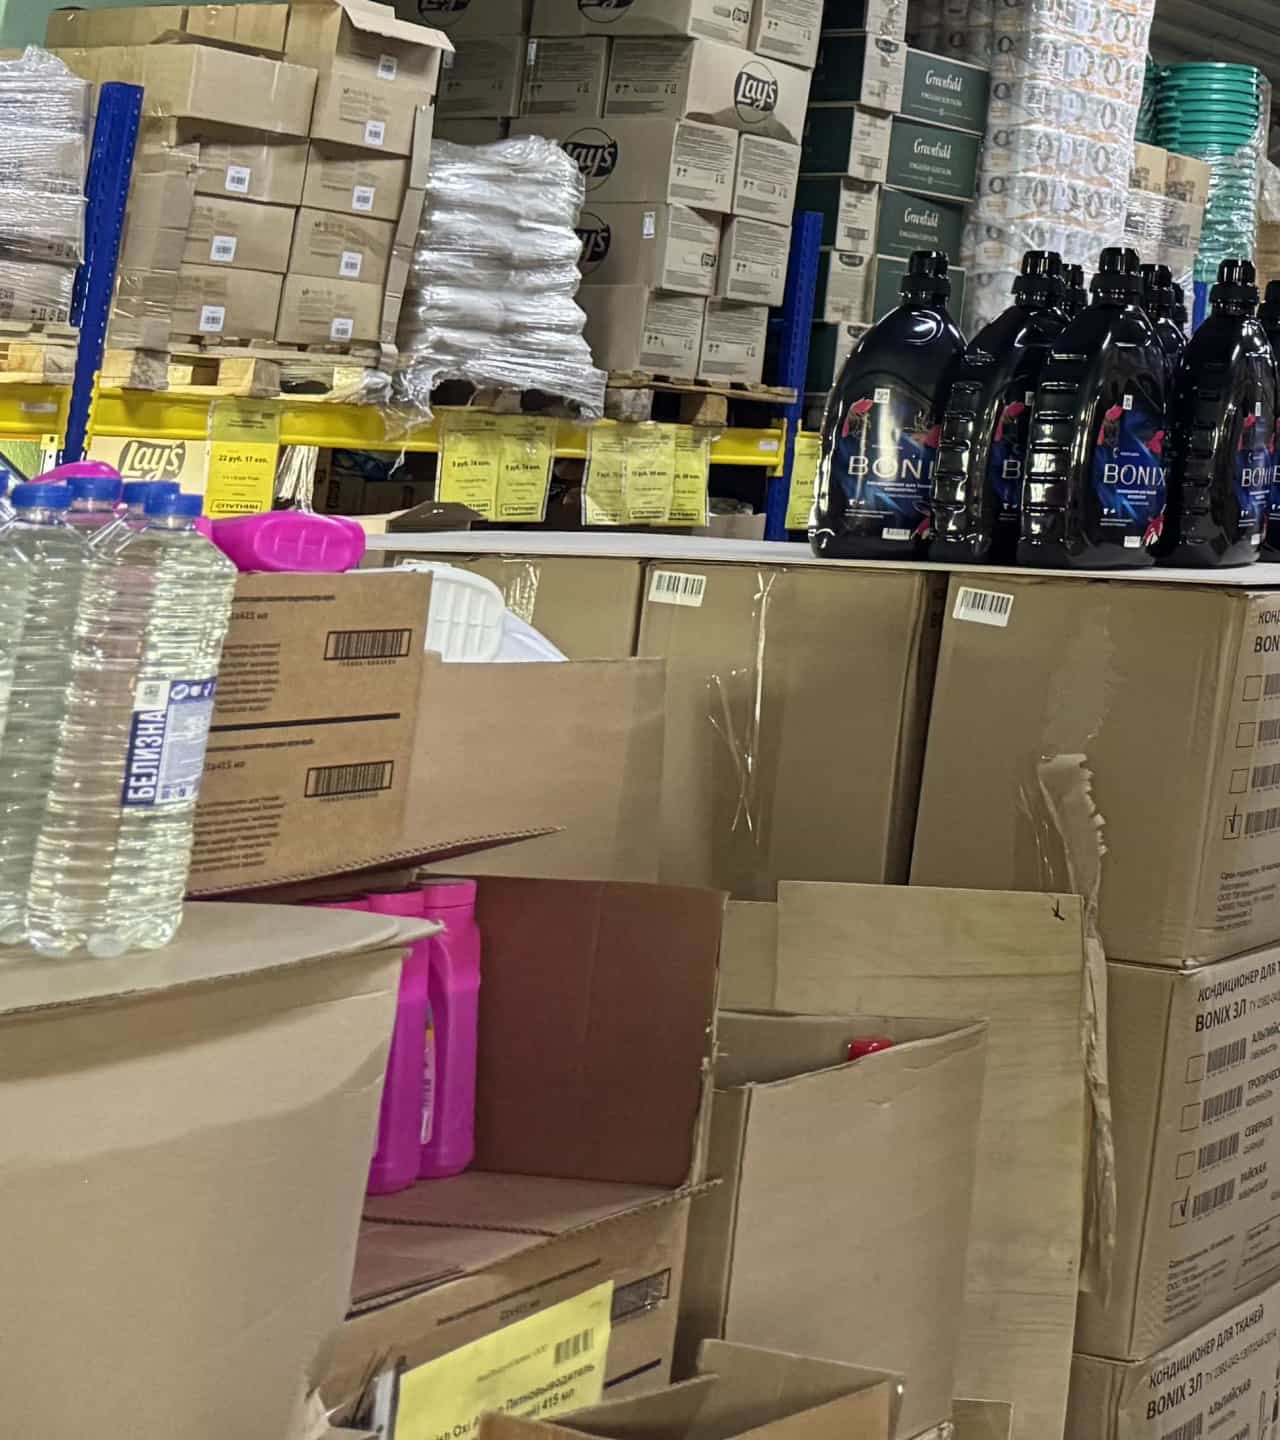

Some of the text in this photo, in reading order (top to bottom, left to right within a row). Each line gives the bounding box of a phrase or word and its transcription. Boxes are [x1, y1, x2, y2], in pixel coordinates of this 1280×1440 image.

[735, 73, 778, 111] Lay's
[924, 69, 963, 94] Greenfield
[913, 137, 952, 160] Greenfield
[122, 440, 186, 480] Lay's
[847, 456, 935, 480] BONI
[1103, 463, 1168, 487] BONIX
[126, 710, 167, 802] БЕЛИЗНА
[1197, 969, 1261, 1003] КОНДИЦИОНЕР
[1260, 961, 1277, 981] ДЛЯ
[1195, 999, 1247, 1033] BONIX 3Л
[1150, 1340, 1217, 1389] КОНДИЦИОНЕР
[1215, 1328, 1235, 1351] ДЛЯ
[1234, 1303, 1265, 1339] ТКАНЕЙ
[505, 1363, 596, 1411] Пятновыводитель
[541, 1392, 561, 1410] 415
[1146, 1372, 1204, 1420] BONIX 3Л
[1208, 1377, 1252, 1416] АЛЬПИЙСКАЯ
